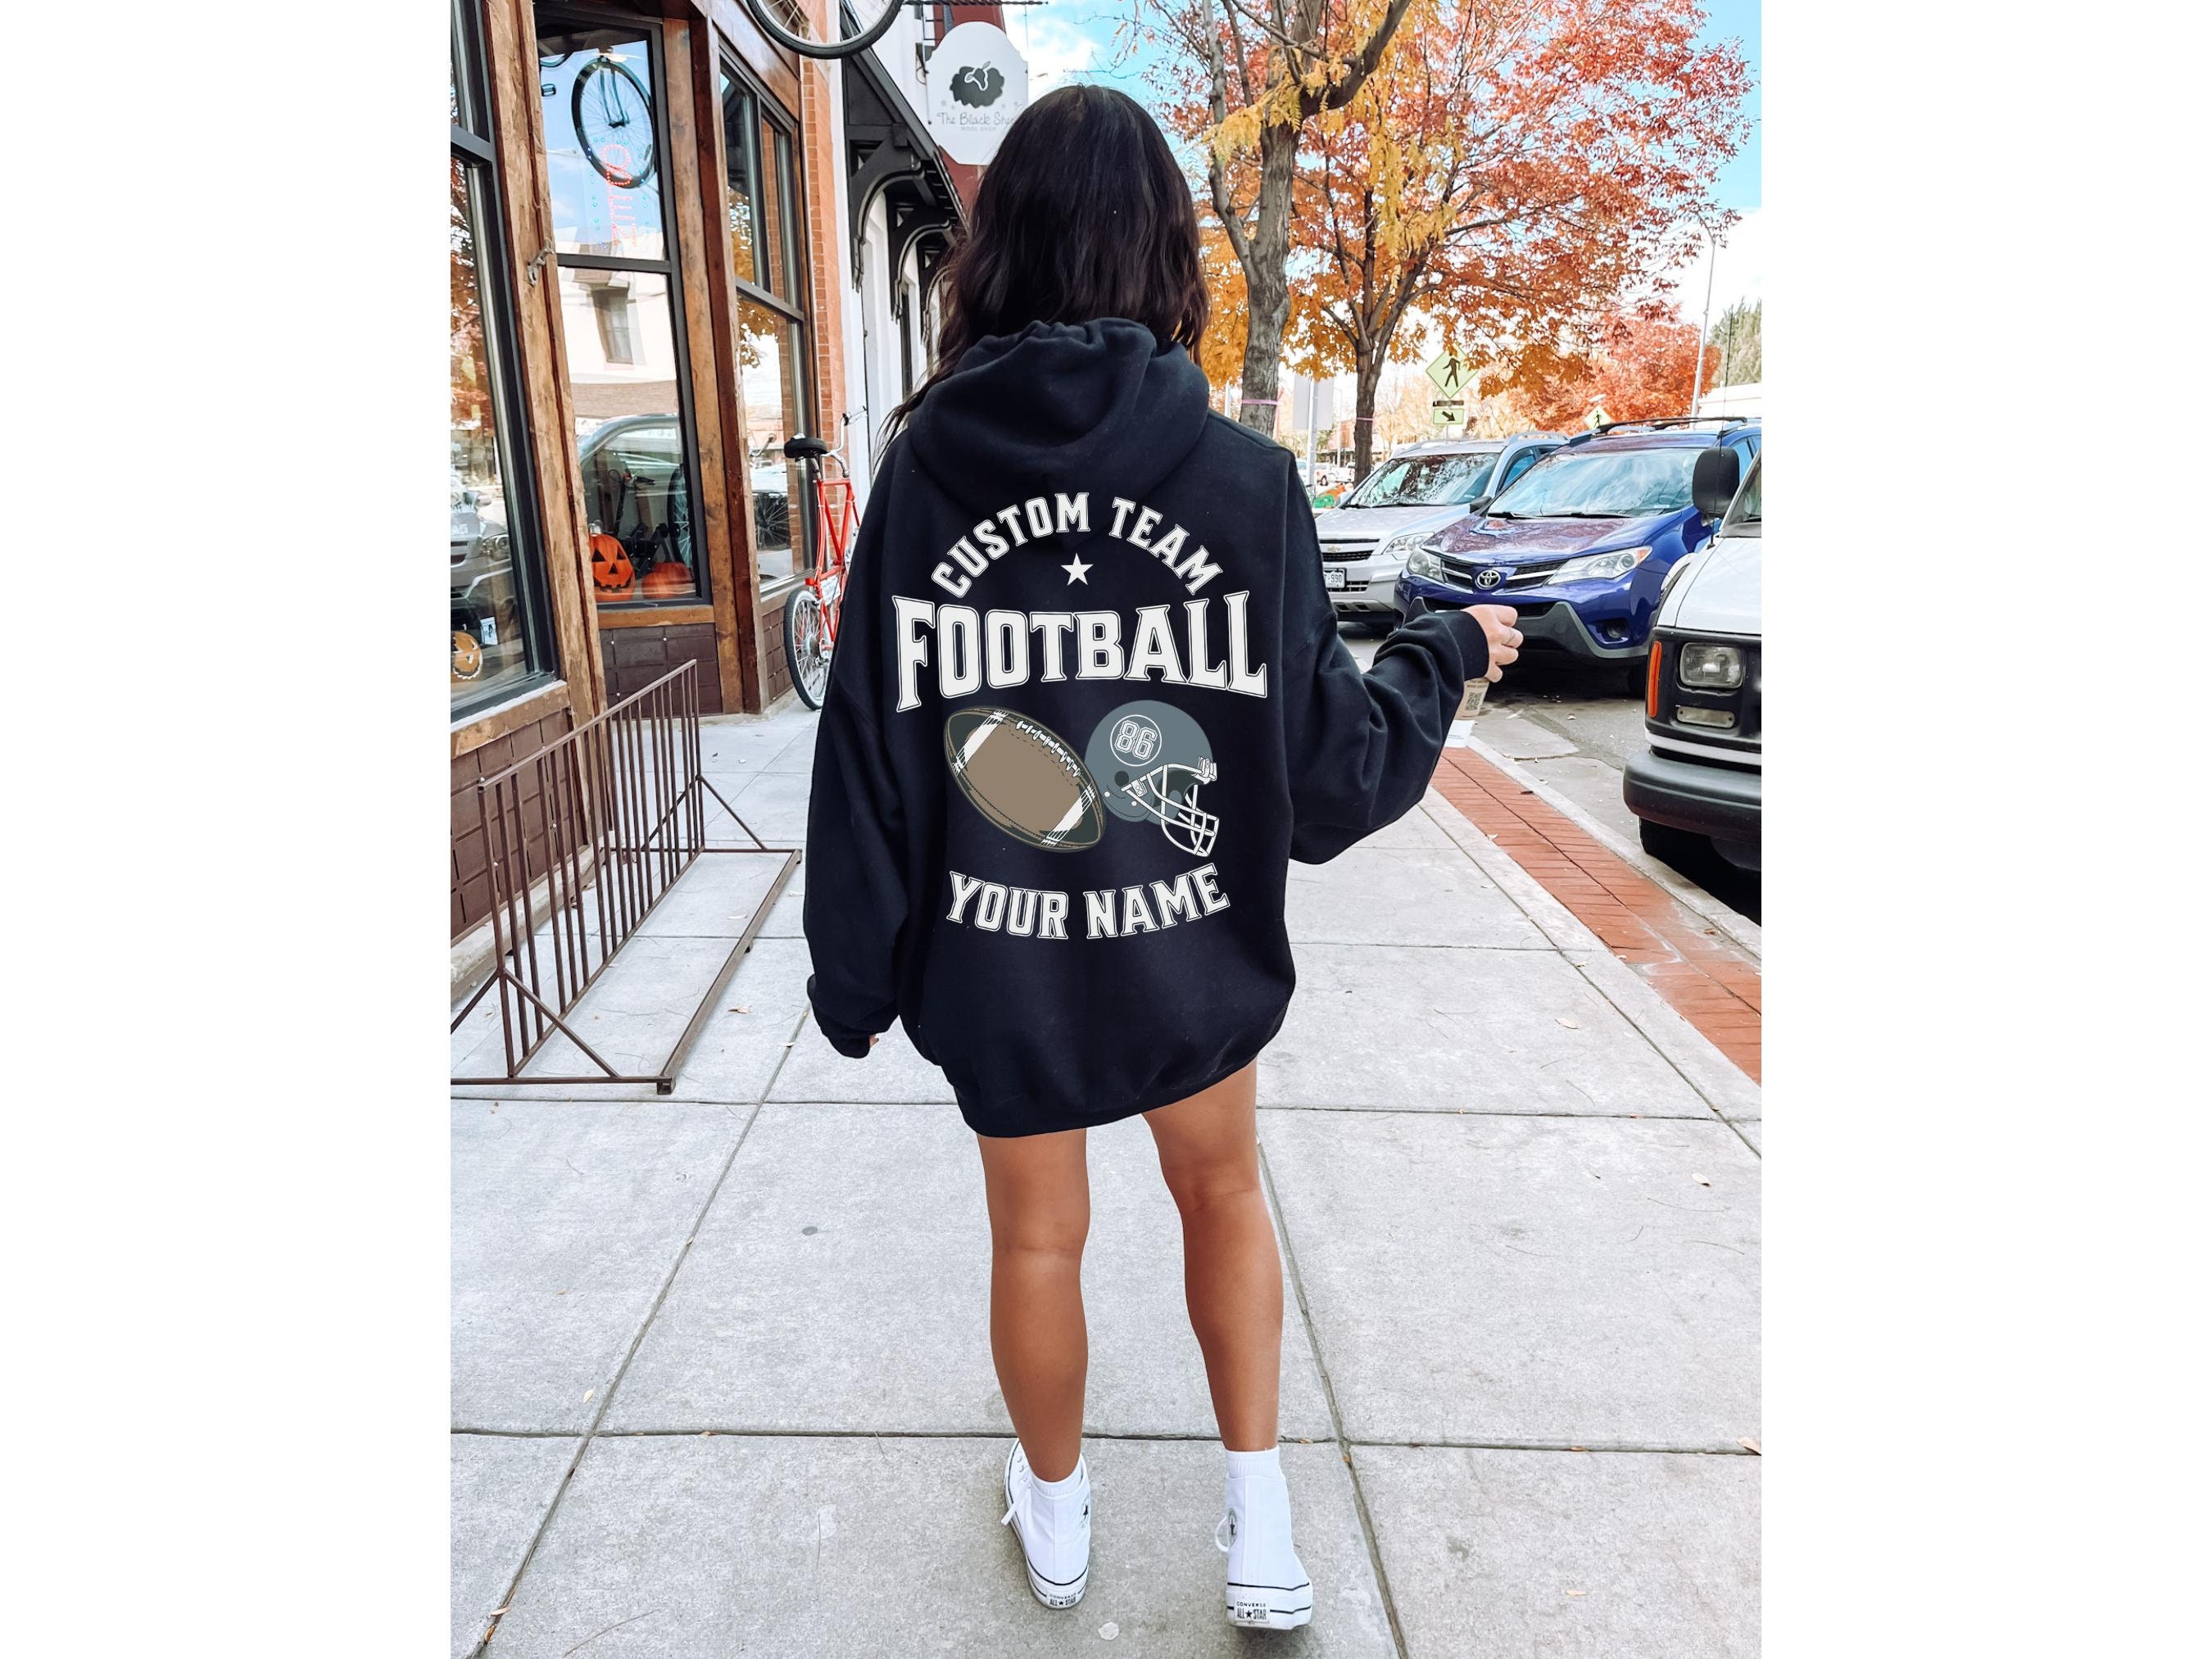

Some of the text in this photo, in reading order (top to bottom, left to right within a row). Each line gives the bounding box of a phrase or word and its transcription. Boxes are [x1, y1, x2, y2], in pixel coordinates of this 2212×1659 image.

[936, 112, 956, 125] The
[959, 111, 990, 125] Black
[931, 492, 1223, 598] CUSTOM TEAM
[892, 591, 1267, 712] FOOTBALL
[1114, 719, 1158, 760] 86
[946, 863, 1231, 940] YOUR NAME
[1237, 1607, 1267, 1620] ALL STAR
